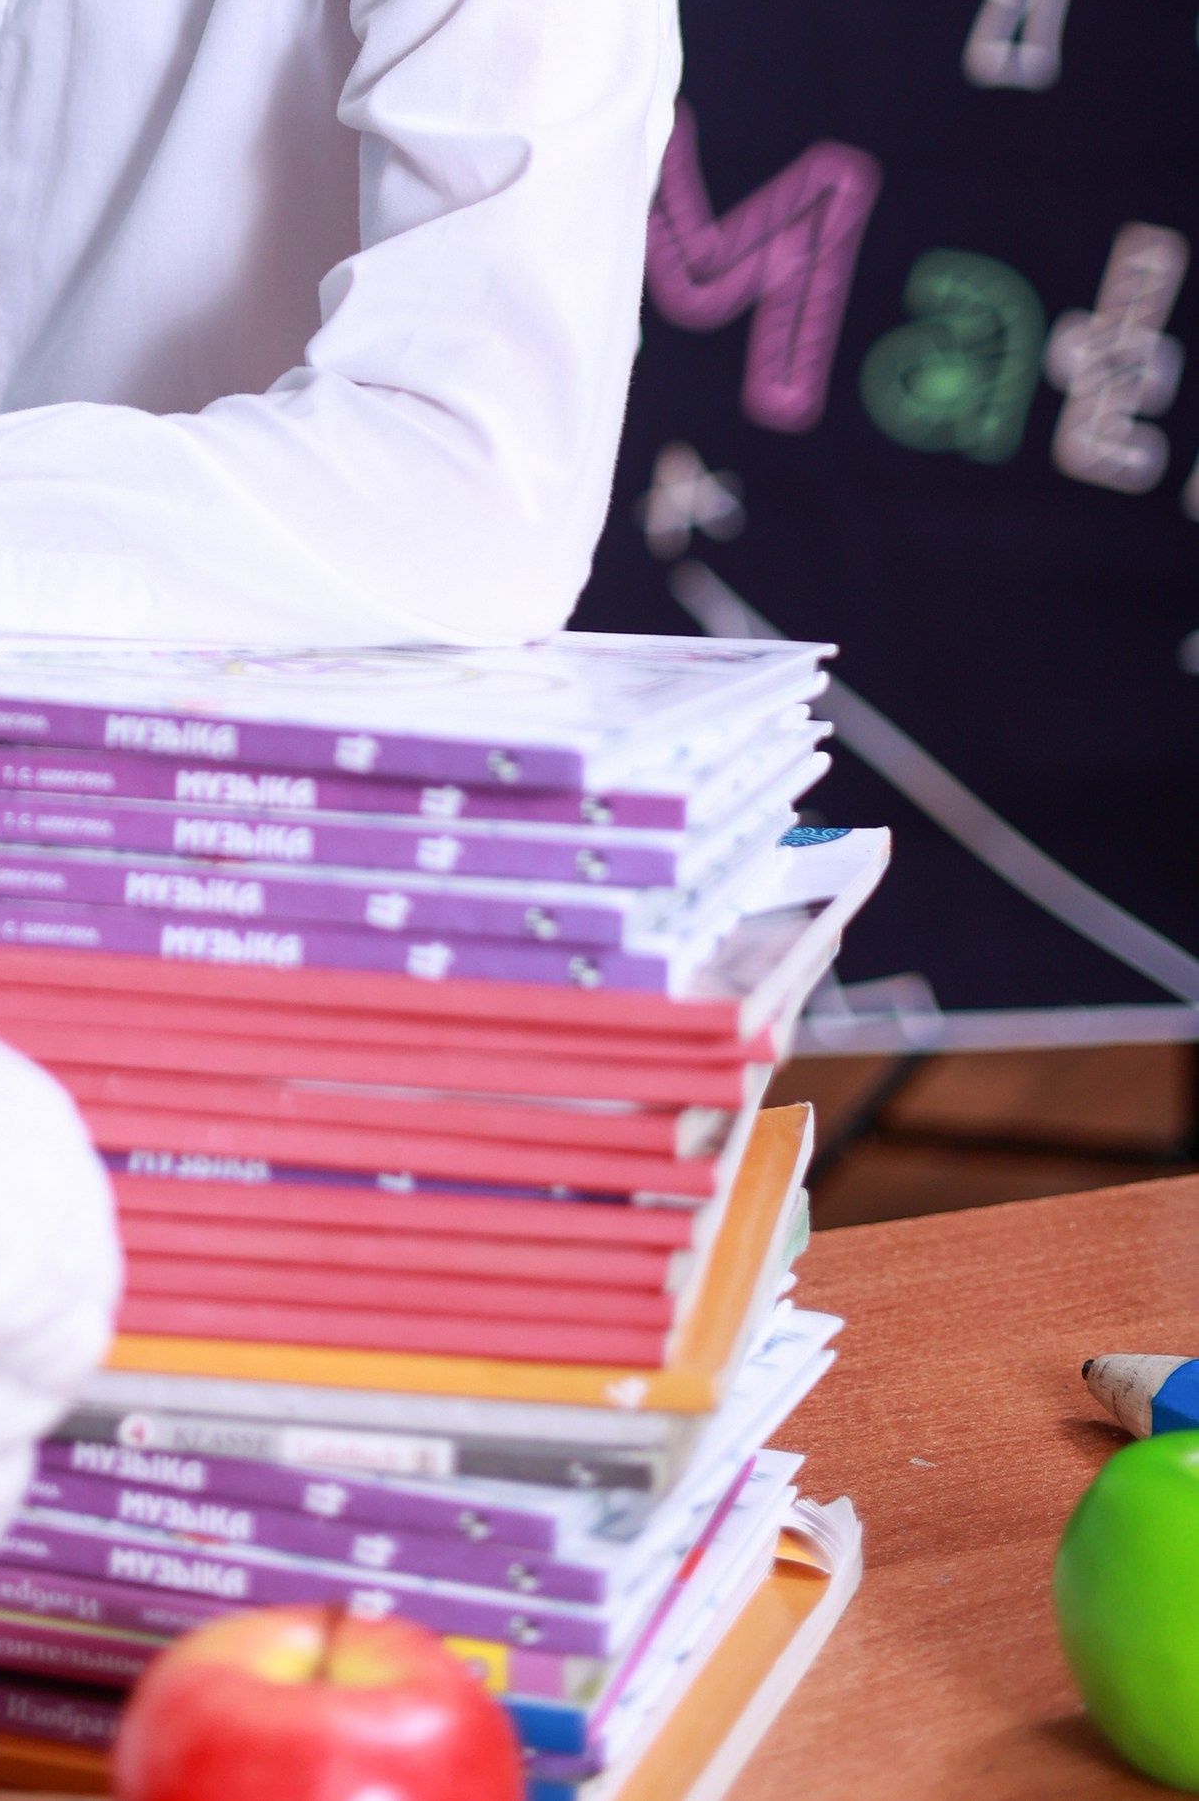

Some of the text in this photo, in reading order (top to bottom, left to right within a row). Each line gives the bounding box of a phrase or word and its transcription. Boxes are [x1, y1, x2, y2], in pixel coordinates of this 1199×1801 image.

[104, 713, 239, 761] МУЗЫКА
[174, 768, 318, 810] МУЗЫКА
[172, 816, 315, 862] МУЗЫКА
[124, 871, 265, 918] МУЗЫКА
[160, 923, 304, 970] МУЗЫКА
[72, 1439, 209, 1491] МУЗЫКА
[118, 1489, 254, 1541] МУЗЫКА
[108, 1546, 249, 1599] МУЗЫКА
